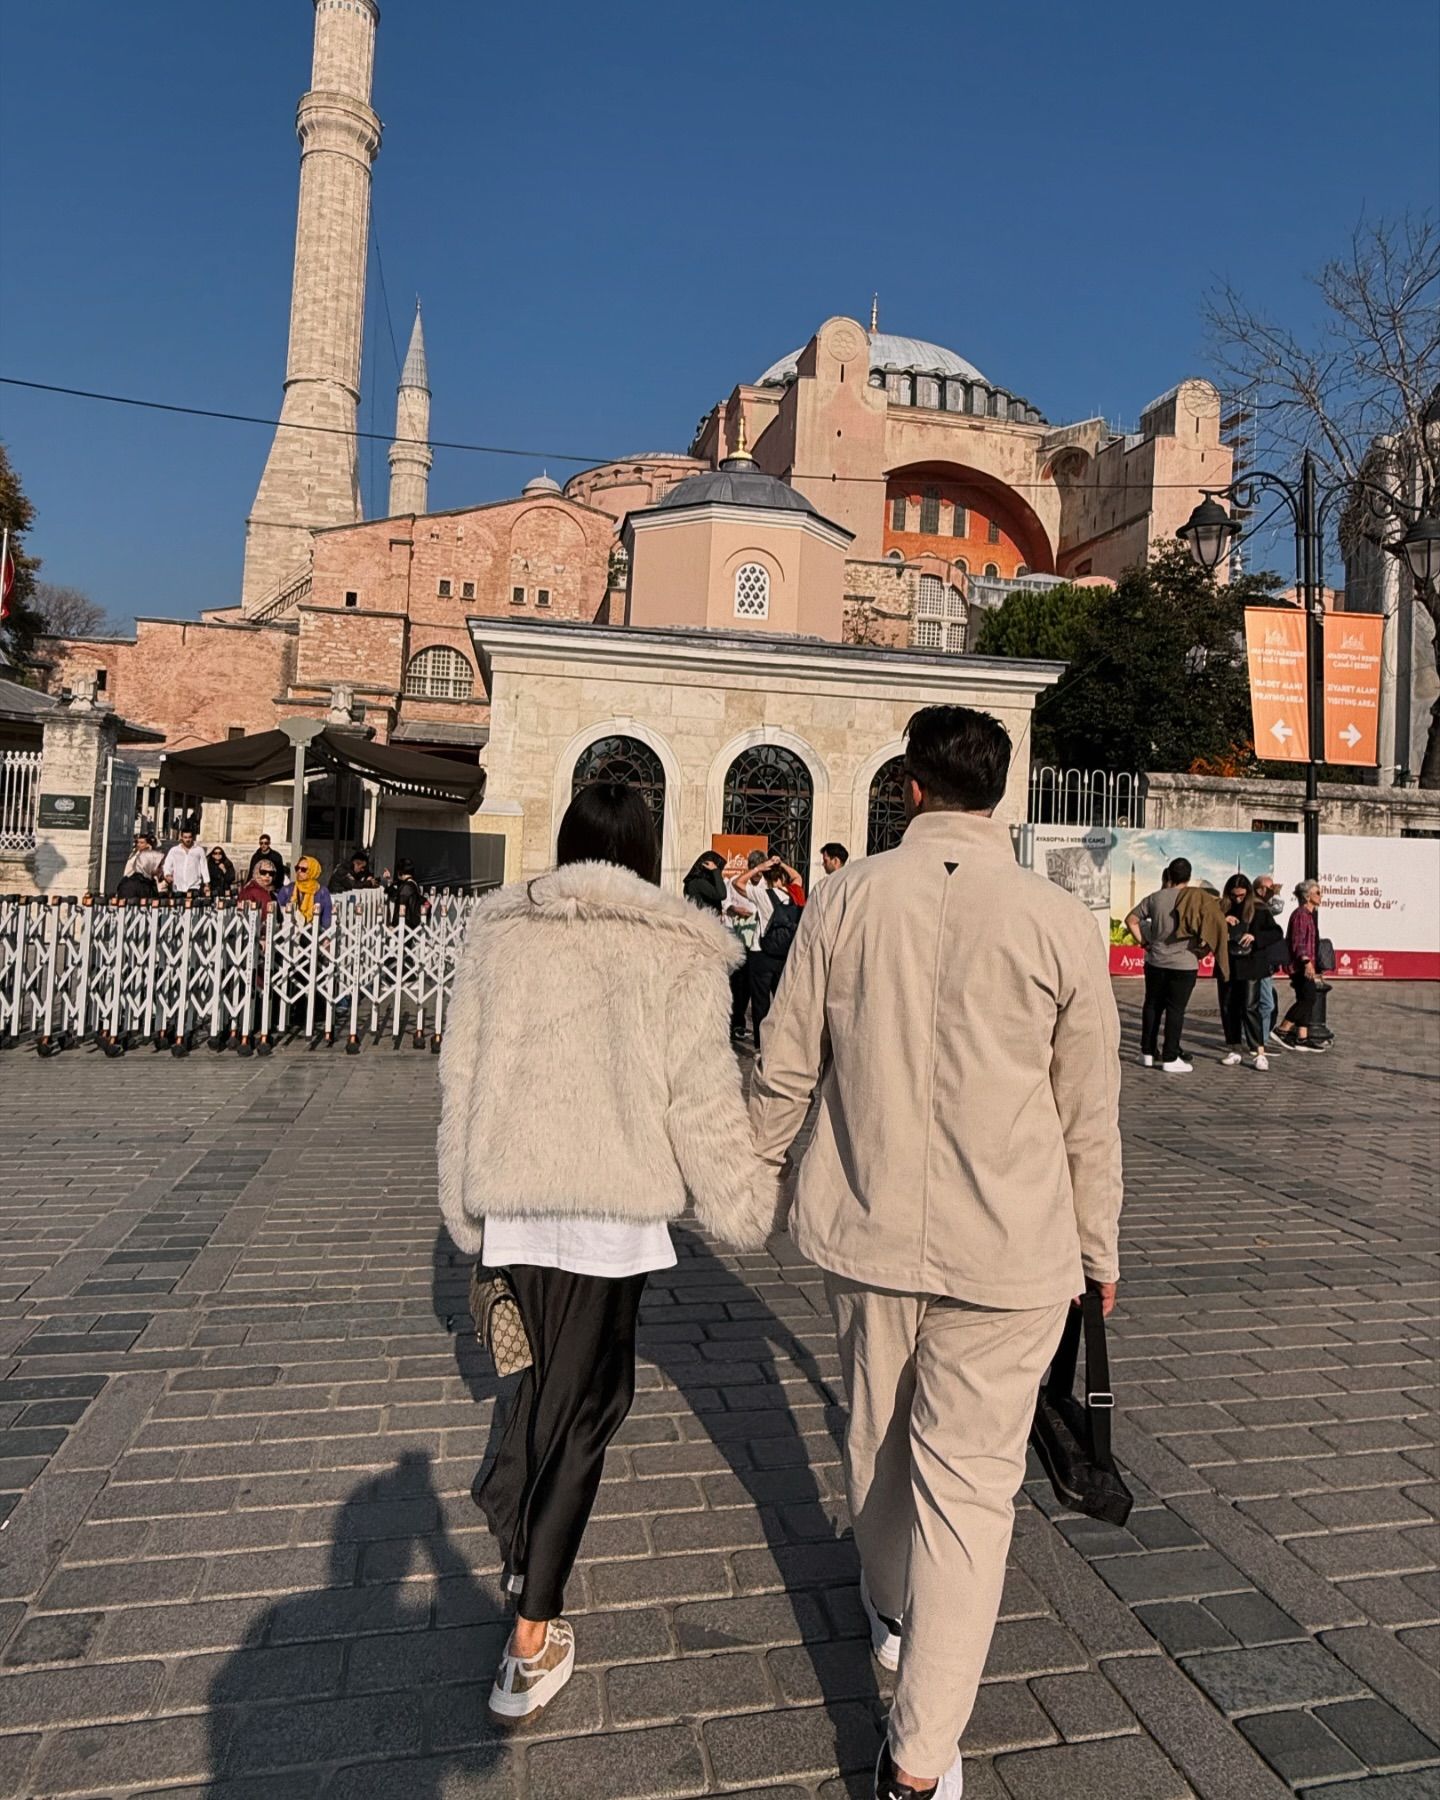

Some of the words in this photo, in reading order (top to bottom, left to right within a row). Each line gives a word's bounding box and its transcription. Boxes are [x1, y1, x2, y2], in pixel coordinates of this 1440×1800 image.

[1357, 699, 1376, 707] AREA
[1350, 874, 1360, 883] bu
[1362, 876, 1378, 884] yana
[1320, 885, 1356, 896] ihimizin
[1321, 898, 1370, 910] niyetimizin
[1120, 954, 1145, 970] Ayas
